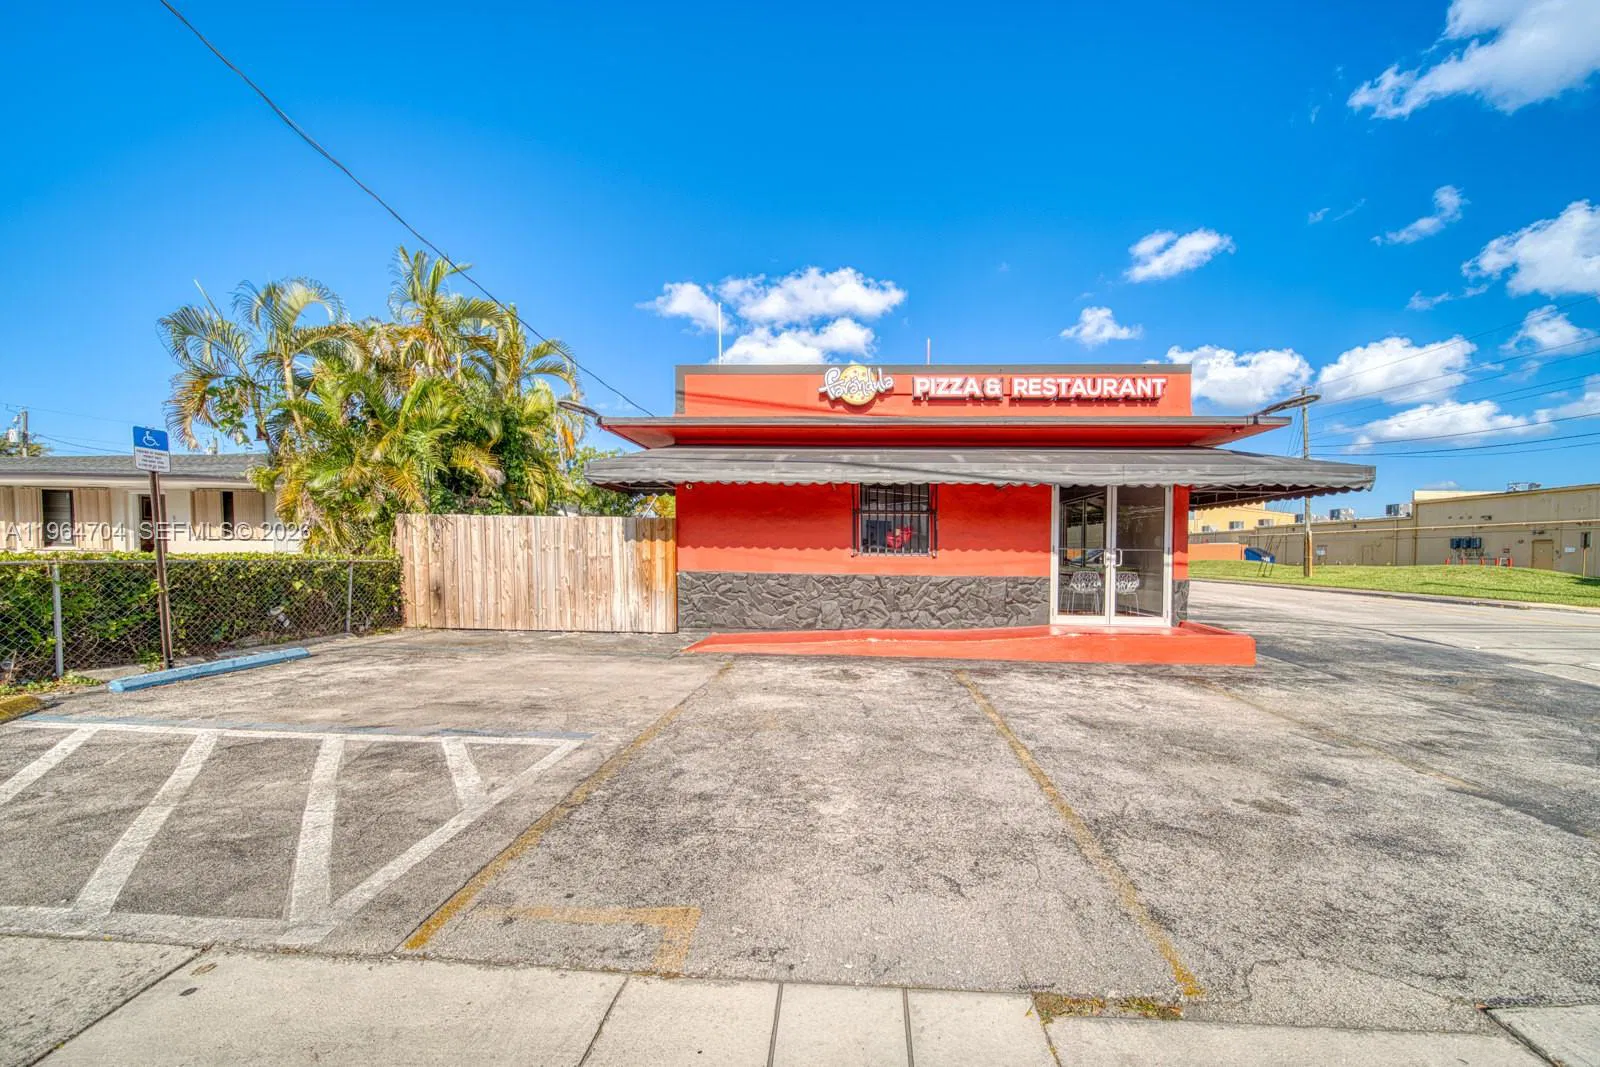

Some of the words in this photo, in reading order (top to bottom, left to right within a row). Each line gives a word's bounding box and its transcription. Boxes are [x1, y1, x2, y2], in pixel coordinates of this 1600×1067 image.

[914, 377, 978, 398] PIZZA
[984, 378, 1002, 398] &
[1012, 378, 1167, 398] RESTAURANT
